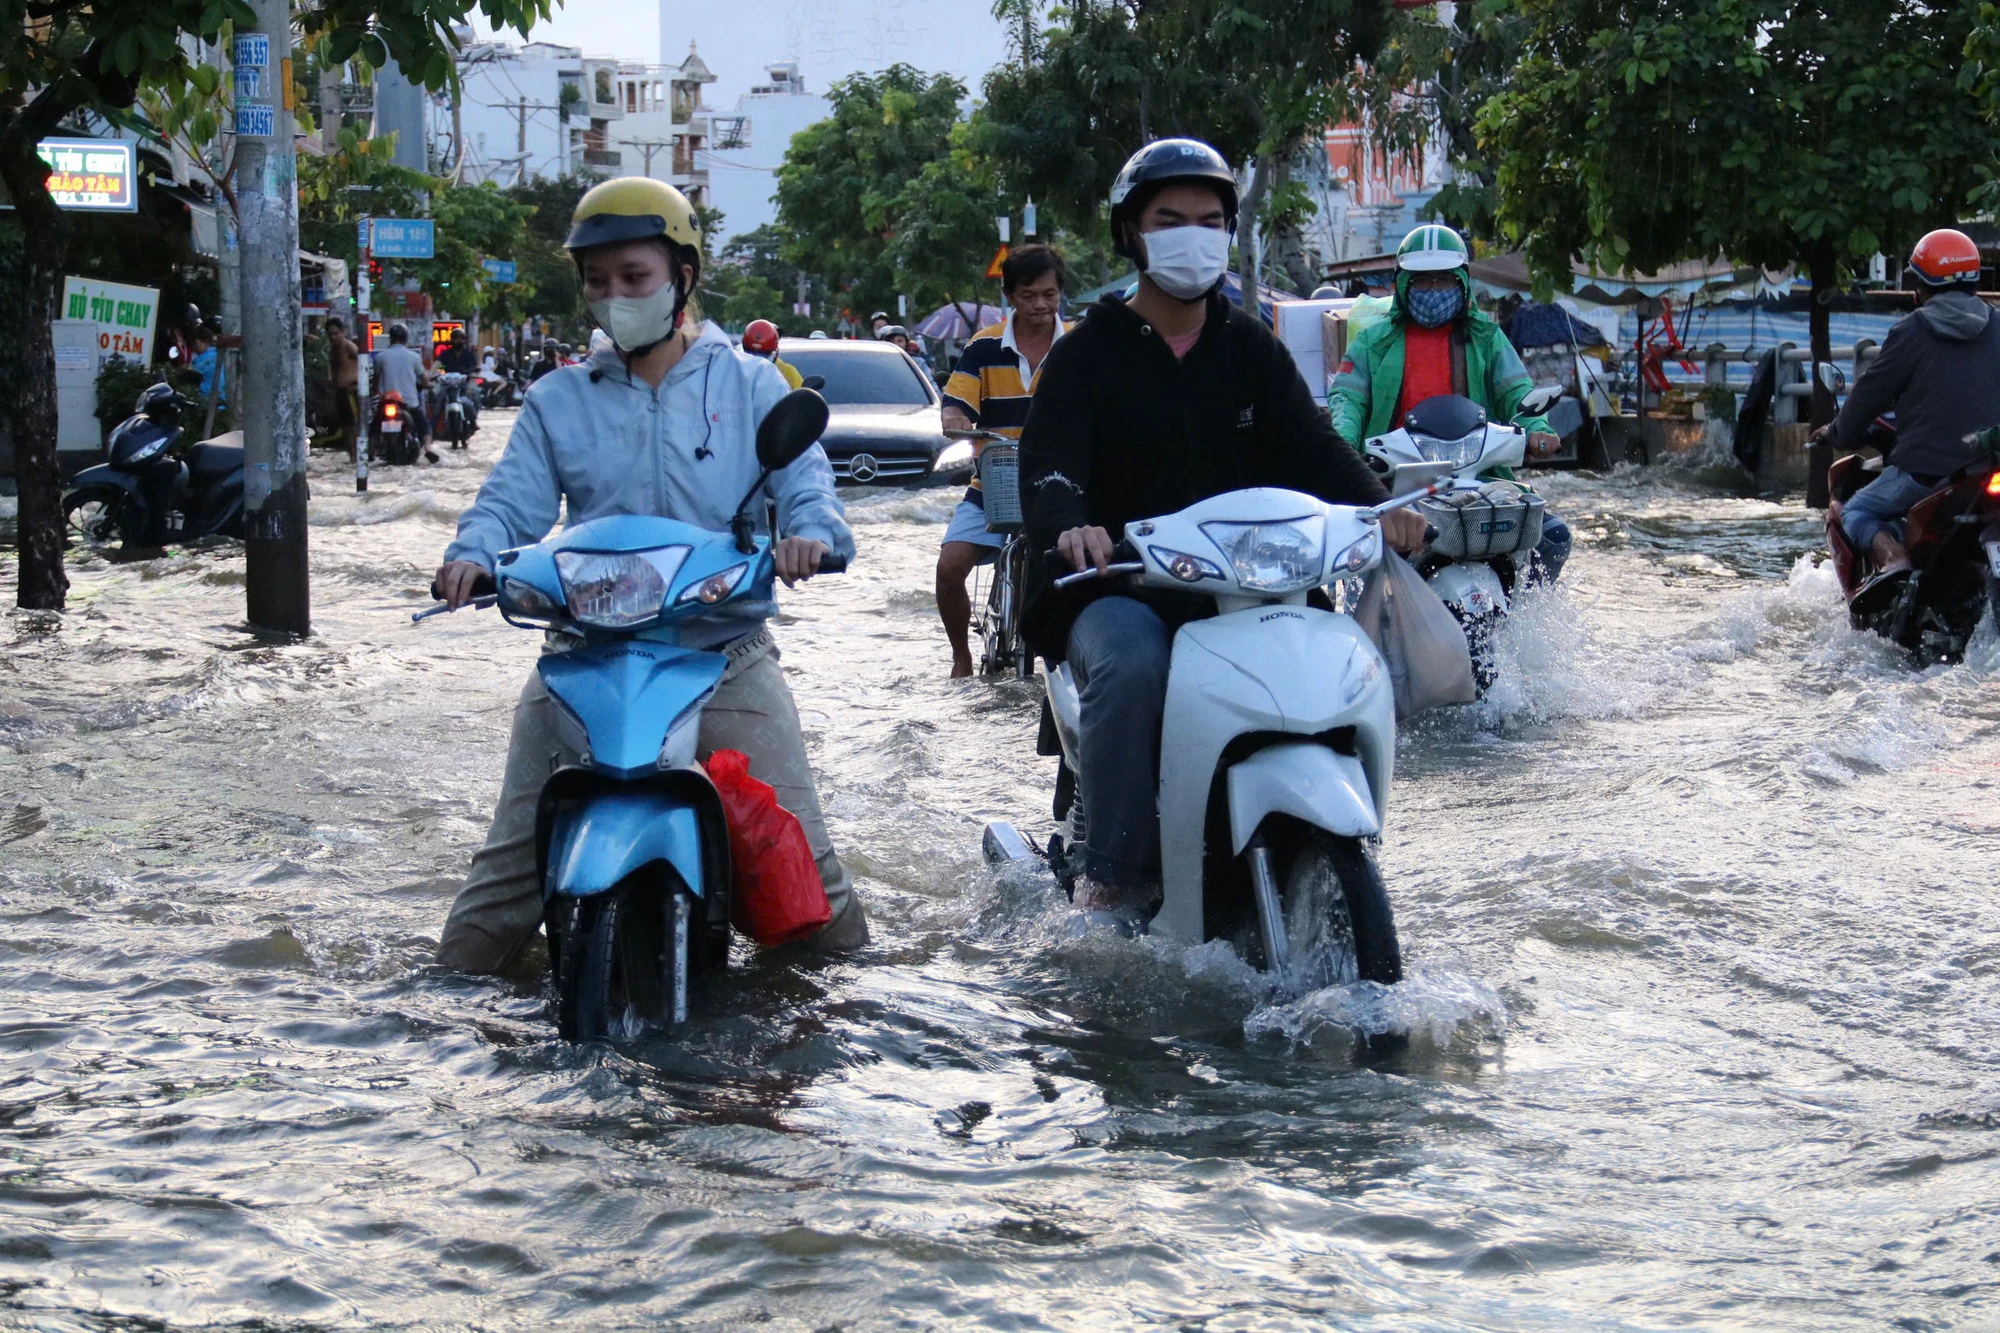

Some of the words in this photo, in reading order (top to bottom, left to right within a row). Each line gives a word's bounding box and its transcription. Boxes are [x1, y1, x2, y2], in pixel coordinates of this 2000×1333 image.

[45, 171, 84, 193] HẢO
[84, 174, 121, 193] TÂM
[68, 285, 88, 320] HỦ
[91, 290, 115, 324] TÍU
[116, 300, 151, 329] CHAY
[113, 330, 144, 355] TÂM
[1259, 611, 1306, 623] HONDA
[605, 649, 656, 660] HONDA
